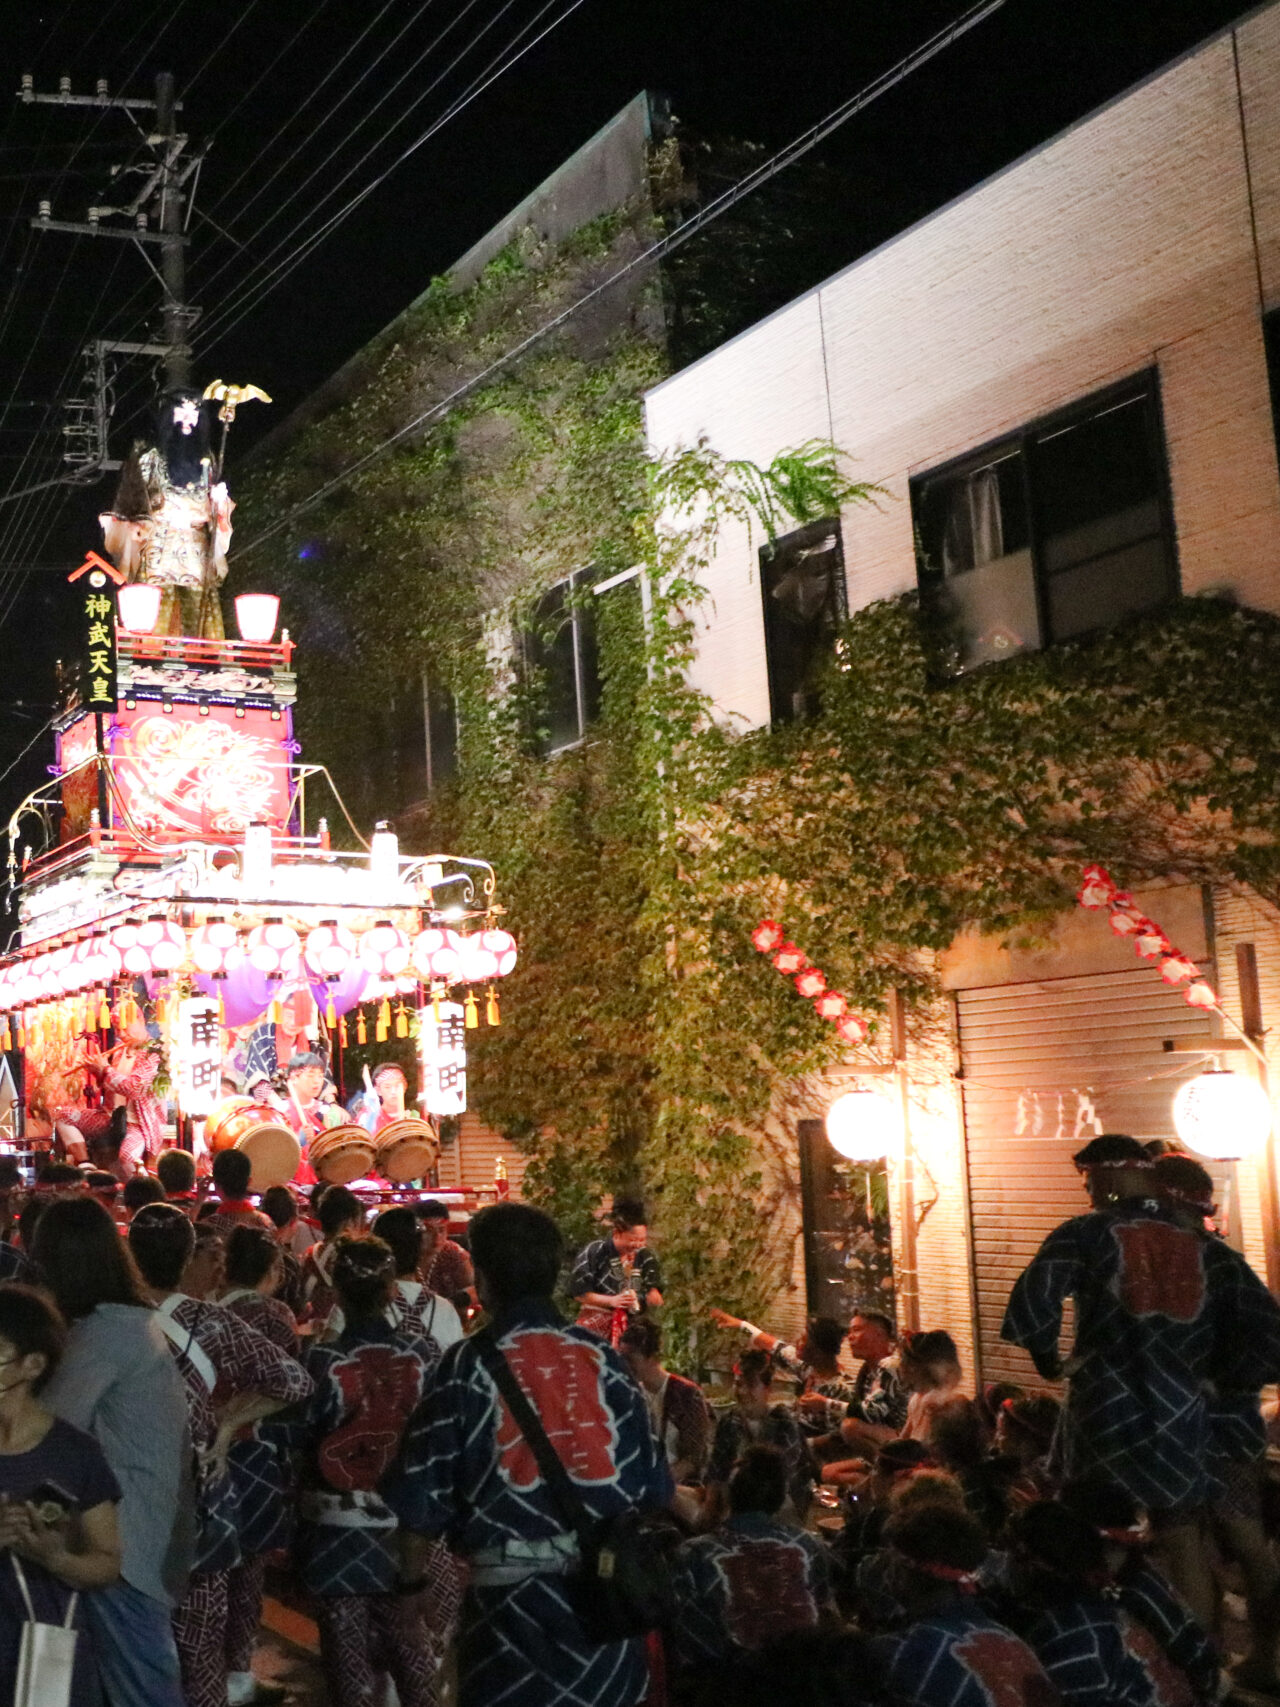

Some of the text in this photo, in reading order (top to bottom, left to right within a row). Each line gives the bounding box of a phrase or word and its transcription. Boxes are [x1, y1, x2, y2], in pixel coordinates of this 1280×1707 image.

[84, 593, 113, 704] 神武天皇
[190, 1008, 220, 1101] 南町
[437, 1013, 466, 1103] 南町
